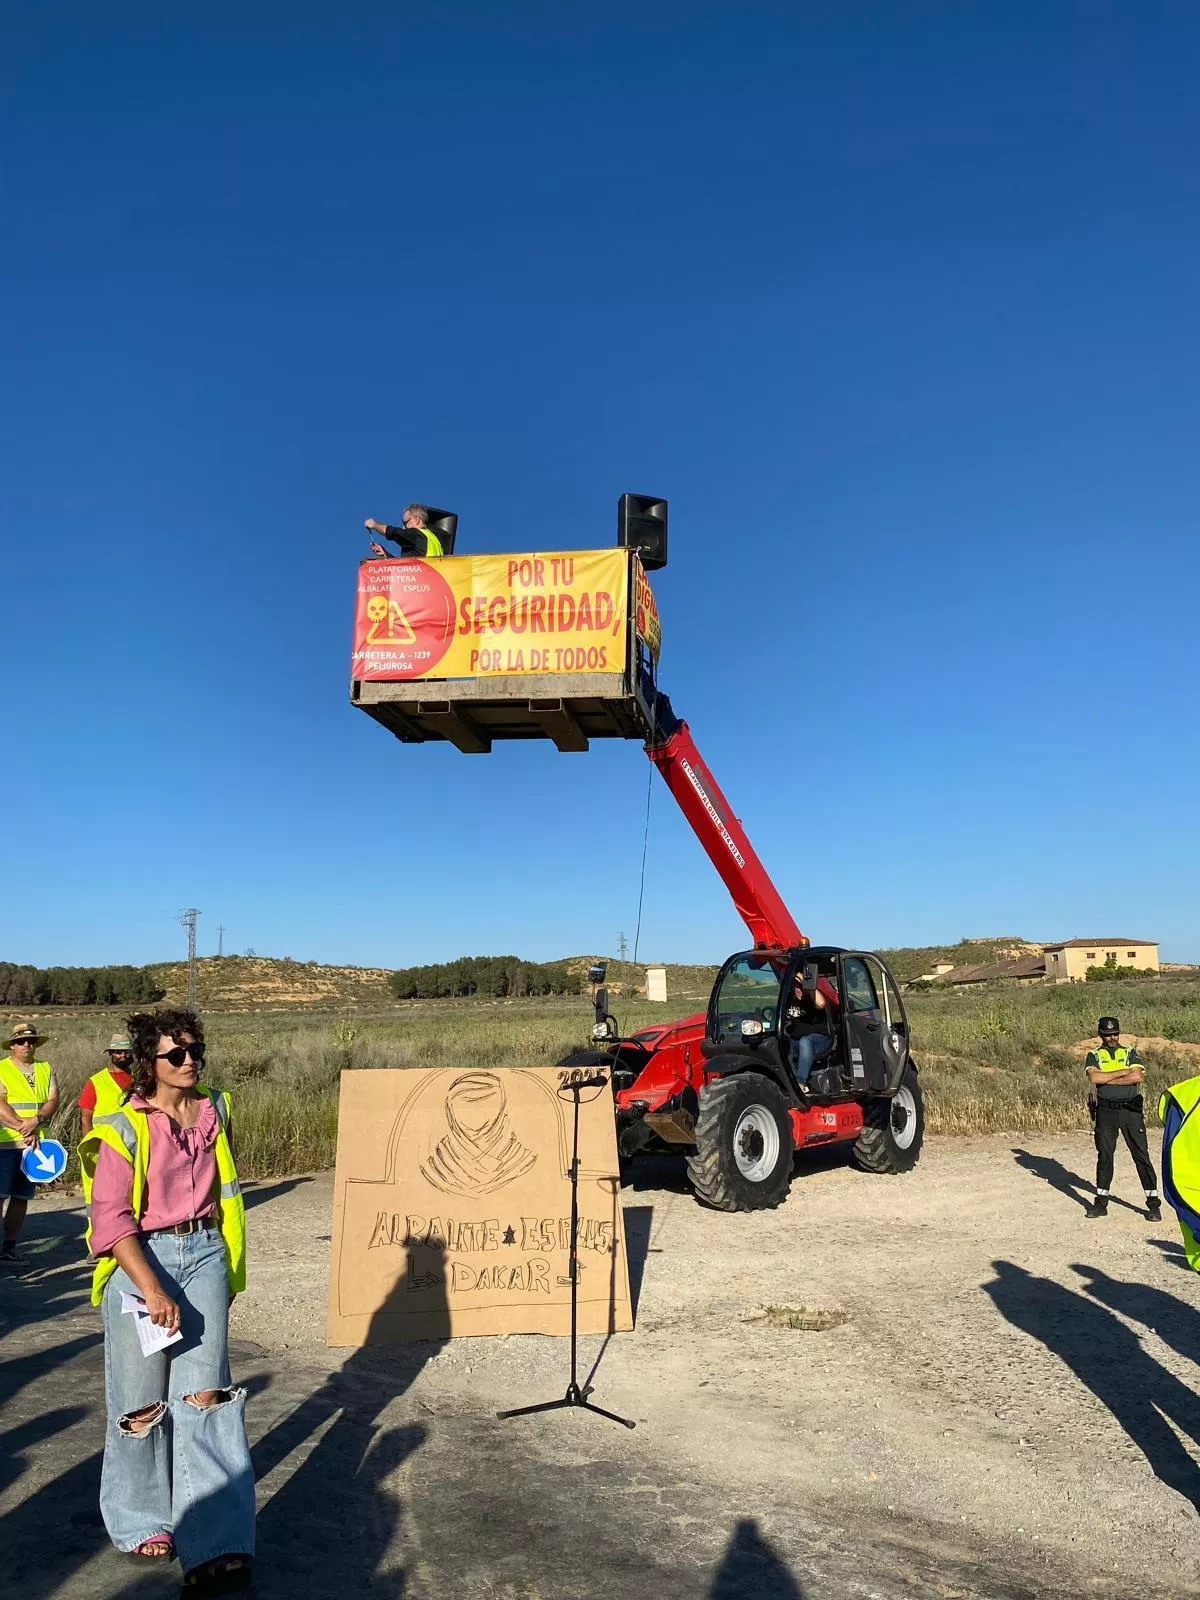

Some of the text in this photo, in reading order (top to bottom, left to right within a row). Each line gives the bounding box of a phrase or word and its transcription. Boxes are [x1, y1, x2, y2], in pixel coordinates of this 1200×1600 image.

[368, 565, 422, 574] PLATAFORMA
[508, 558, 574, 587] POR TU
[459, 592, 621, 636] SEGURIDAD,
[368, 662, 413, 670] PELIGROSA
[399, 651, 405, 659] A
[414, 651, 431, 659] 1239
[470, 646, 607, 672] POR LA DE TODOS
[451, 1257, 551, 1294] DAKAR
